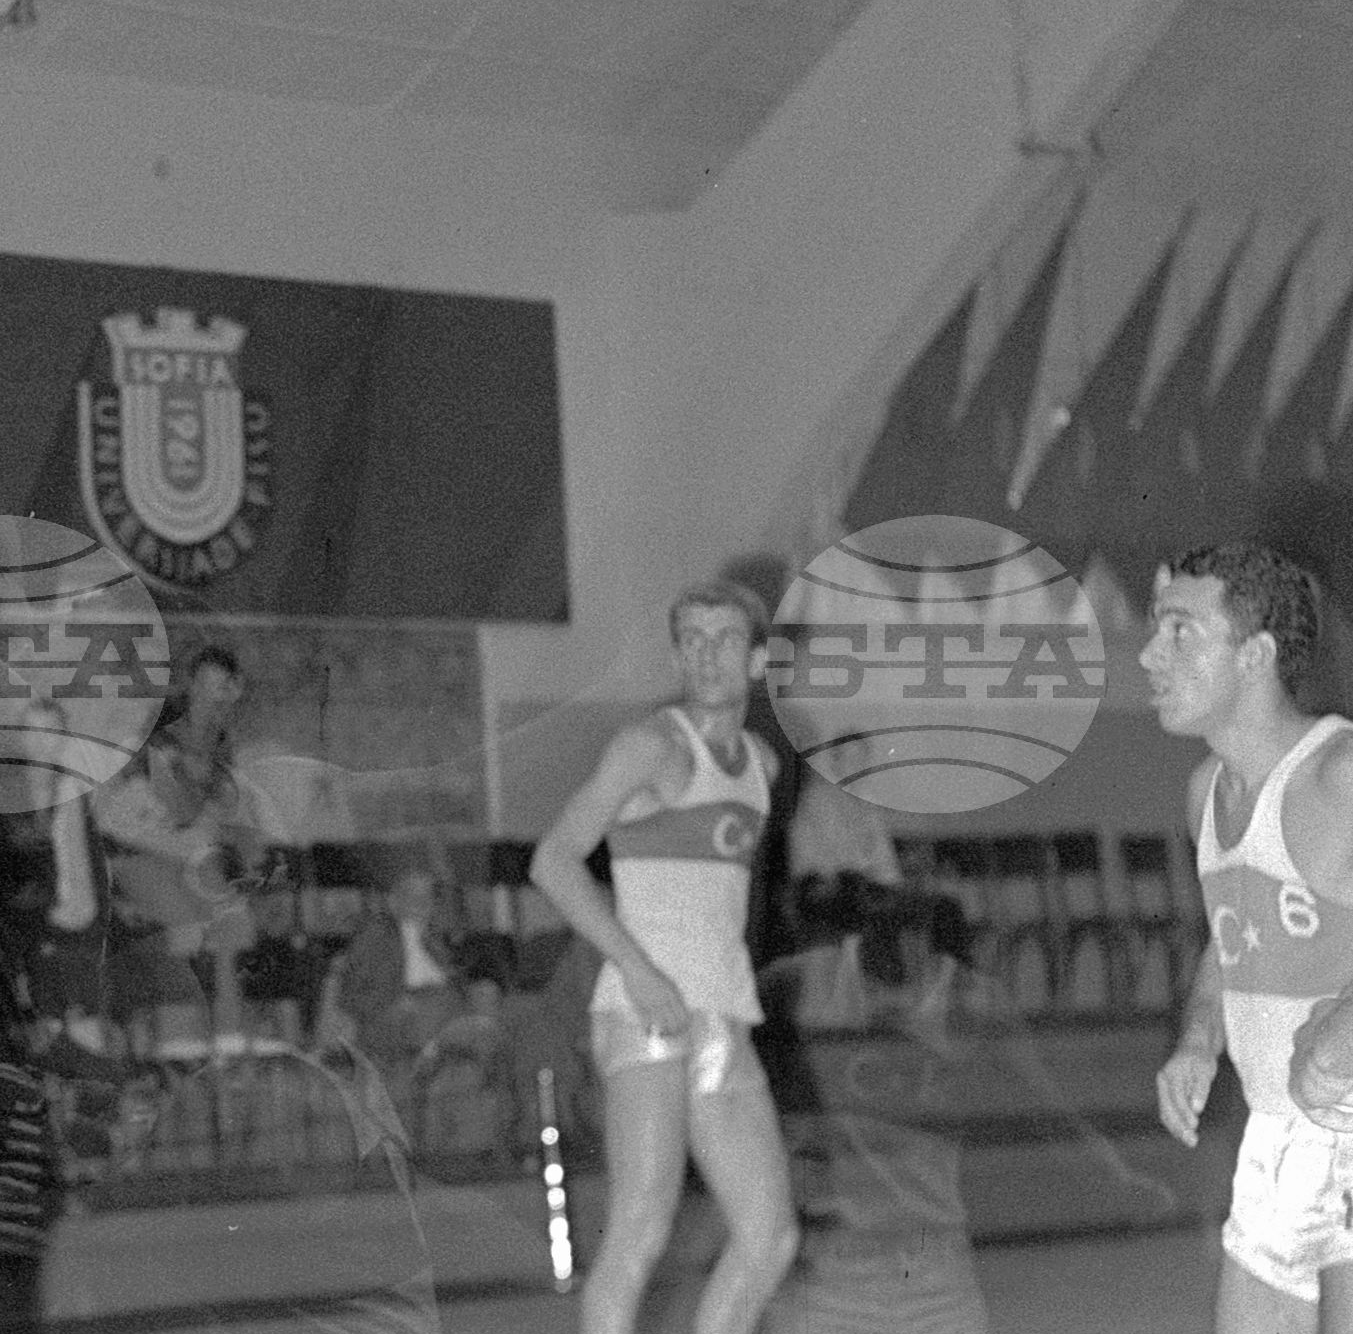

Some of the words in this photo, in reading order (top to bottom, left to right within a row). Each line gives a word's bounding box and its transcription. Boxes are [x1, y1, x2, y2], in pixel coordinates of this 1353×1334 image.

[128, 353, 234, 384] SOFIA
[166, 398, 200, 479] 1961
[1278, 884, 1320, 939] 6
